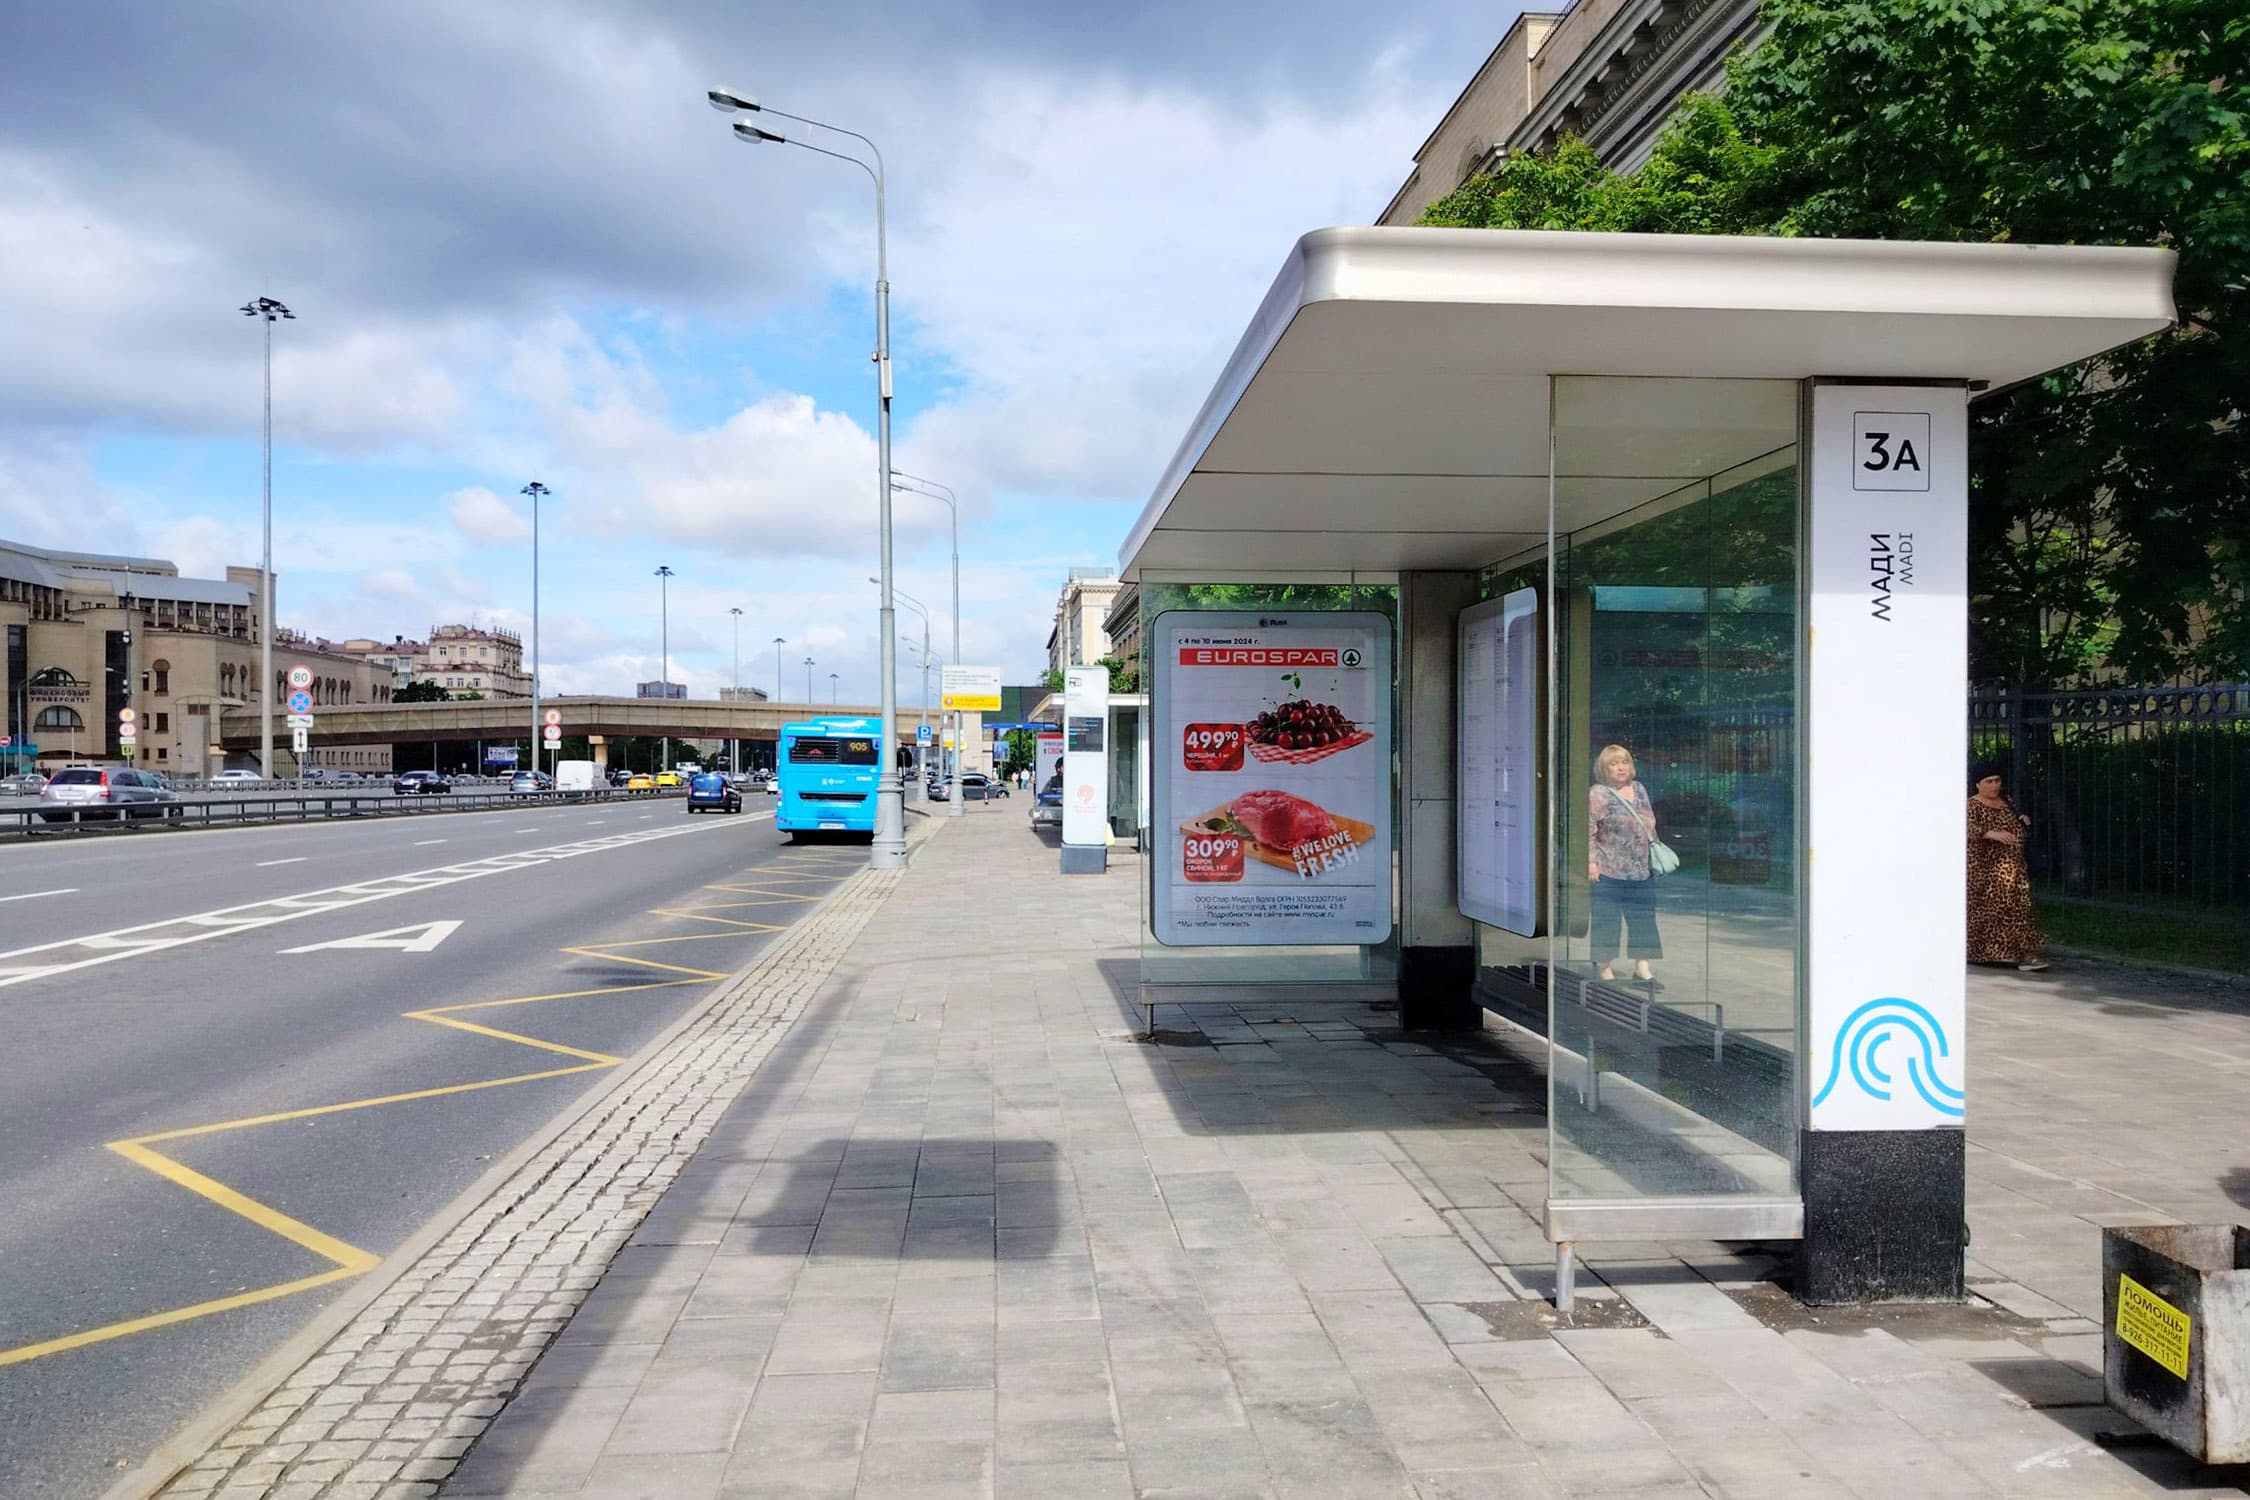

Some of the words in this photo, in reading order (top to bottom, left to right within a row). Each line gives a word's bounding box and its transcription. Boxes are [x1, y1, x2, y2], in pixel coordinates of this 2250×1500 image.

[1899, 532, 1913, 585] MADI
[1870, 533, 1895, 622] МАДИ
[1196, 651, 1337, 663] EUROSPAR
[294, 672, 308, 682] 80
[849, 742, 867, 751] 905
[1186, 731, 1225, 749] 499
[1225, 731, 1239, 741] 90
[1186, 839, 1225, 857] 309
[1225, 839, 1239, 849] 90
[1292, 840, 1322, 861] #WE
[1322, 830, 1352, 850] LOVE
[2124, 1286, 2183, 1334] ПОМОЩЬ
